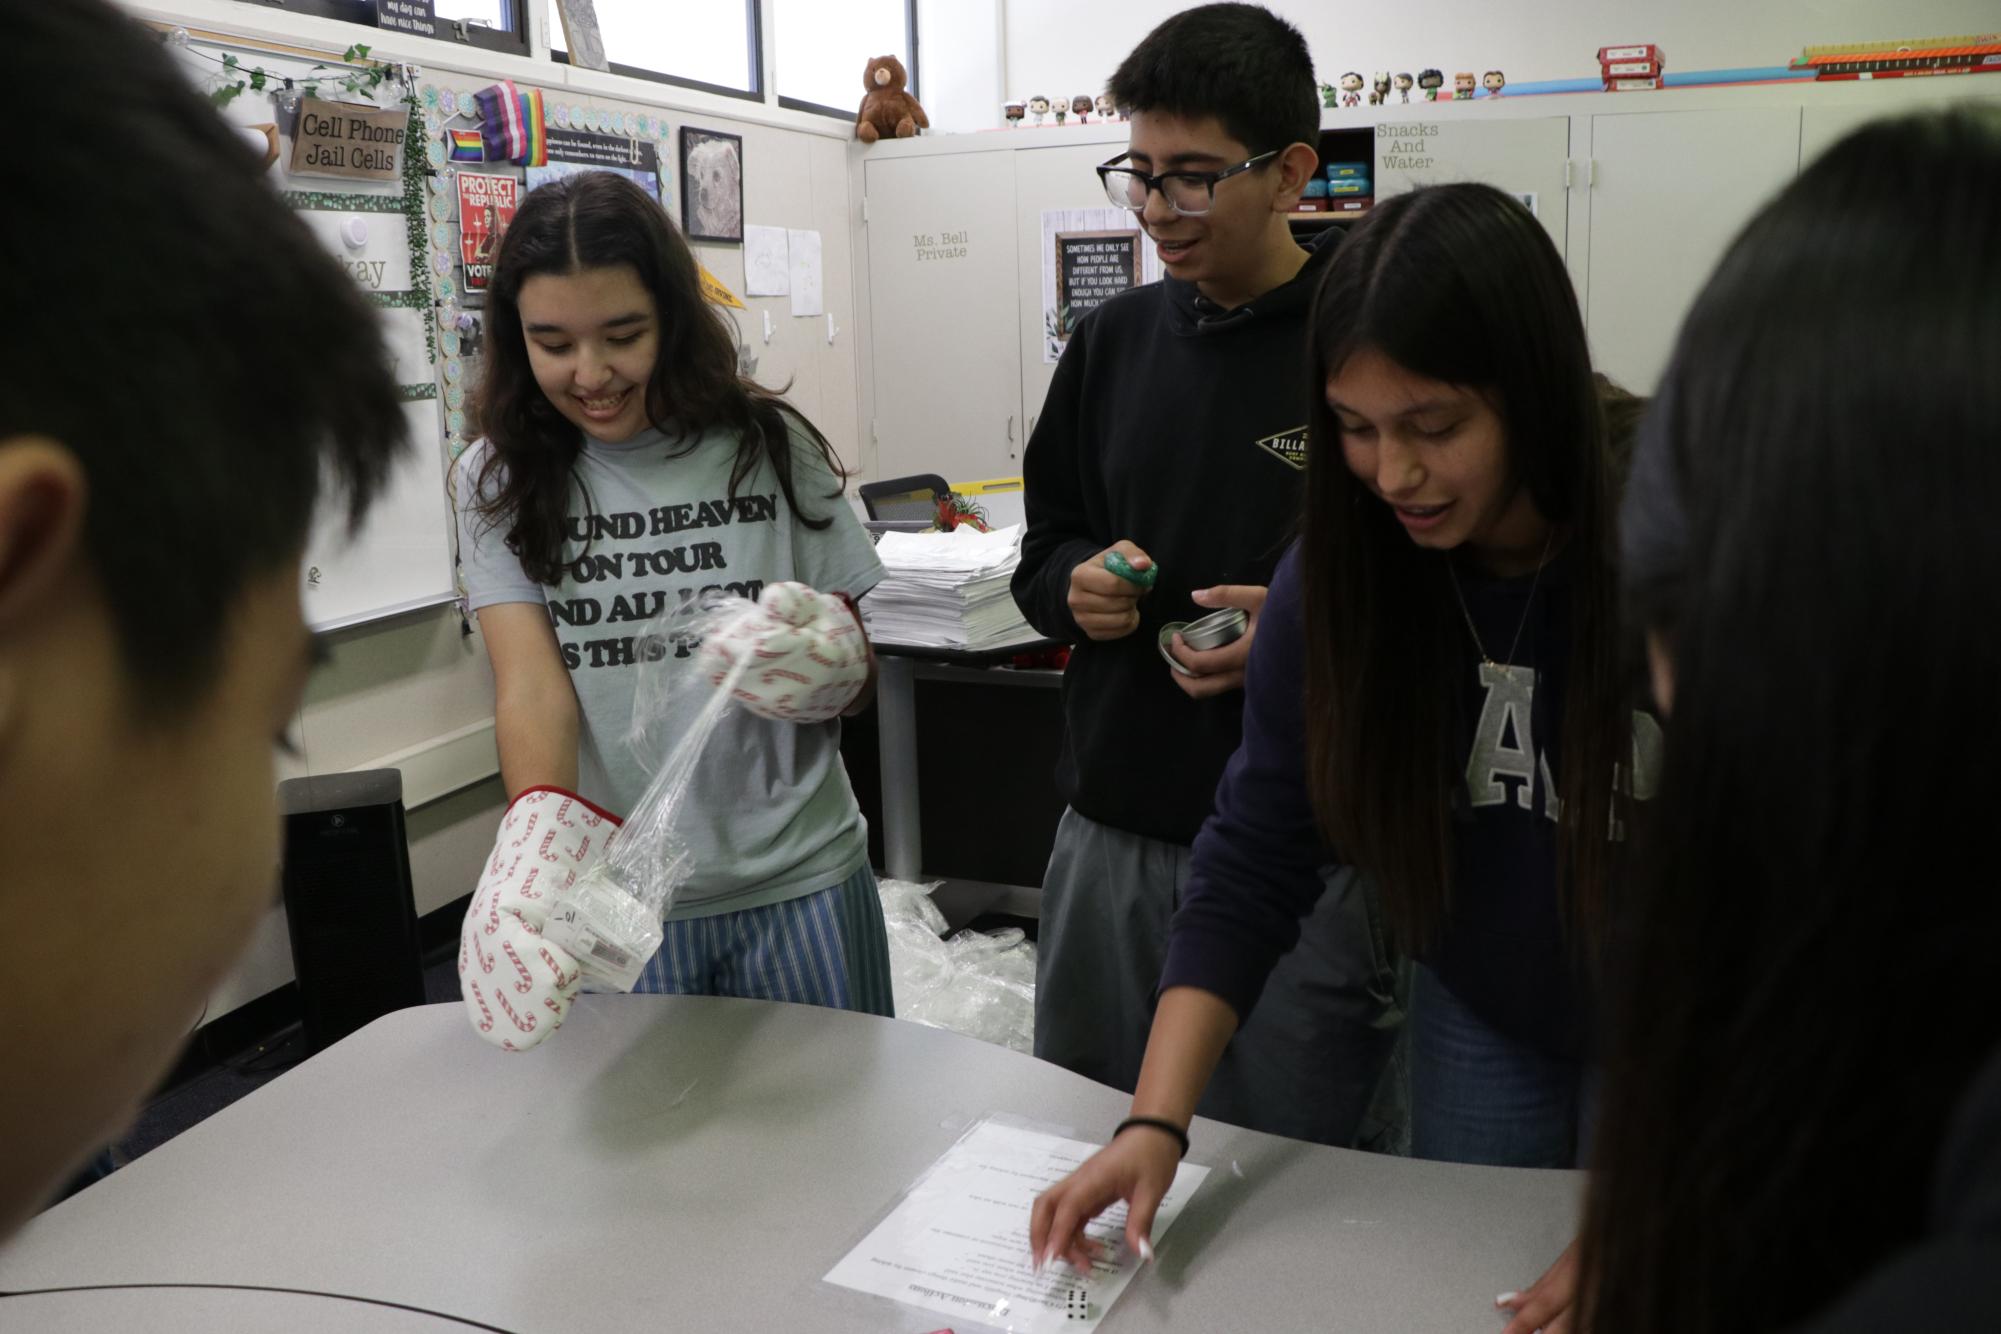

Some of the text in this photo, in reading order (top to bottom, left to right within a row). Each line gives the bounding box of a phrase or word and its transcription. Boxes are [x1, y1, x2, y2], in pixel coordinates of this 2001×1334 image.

[303, 113, 404, 144] Cell Phone
[1377, 122, 1439, 137] Snacks
[1391, 139, 1425, 153] And
[306, 144, 393, 170] Jail Cells
[1382, 156, 1434, 169] Water
[461, 176, 513, 196] PROTECT
[470, 194, 512, 208] REPUBLIC
[913, 231, 968, 247] Ms. Bell
[917, 247, 967, 261] Private
[1066, 243, 1129, 254] SOMETIMES WE ONLY SEE
[1077, 254, 1119, 264] HOW PEOPLE ARE
[1072, 266, 1097, 275] DIFFERENT
[1099, 266, 1113, 274] FROM
[1069, 278, 1079, 286] BUT
[1087, 277, 1097, 285] YOU
[1099, 277, 1112, 285] LOOK
[1114, 276, 1127, 285] HARD
[1072, 288, 1092, 296] ENOUGH
[1092, 288, 1103, 296] YOU
[1071, 299, 1082, 307] HOW
[567, 494, 777, 542] UND HEAVEN
[571, 542, 727, 583] ON TOUR
[548, 598, 602, 626] ND
[606, 590, 666, 623] ALL
[583, 635, 666, 668] THIS
